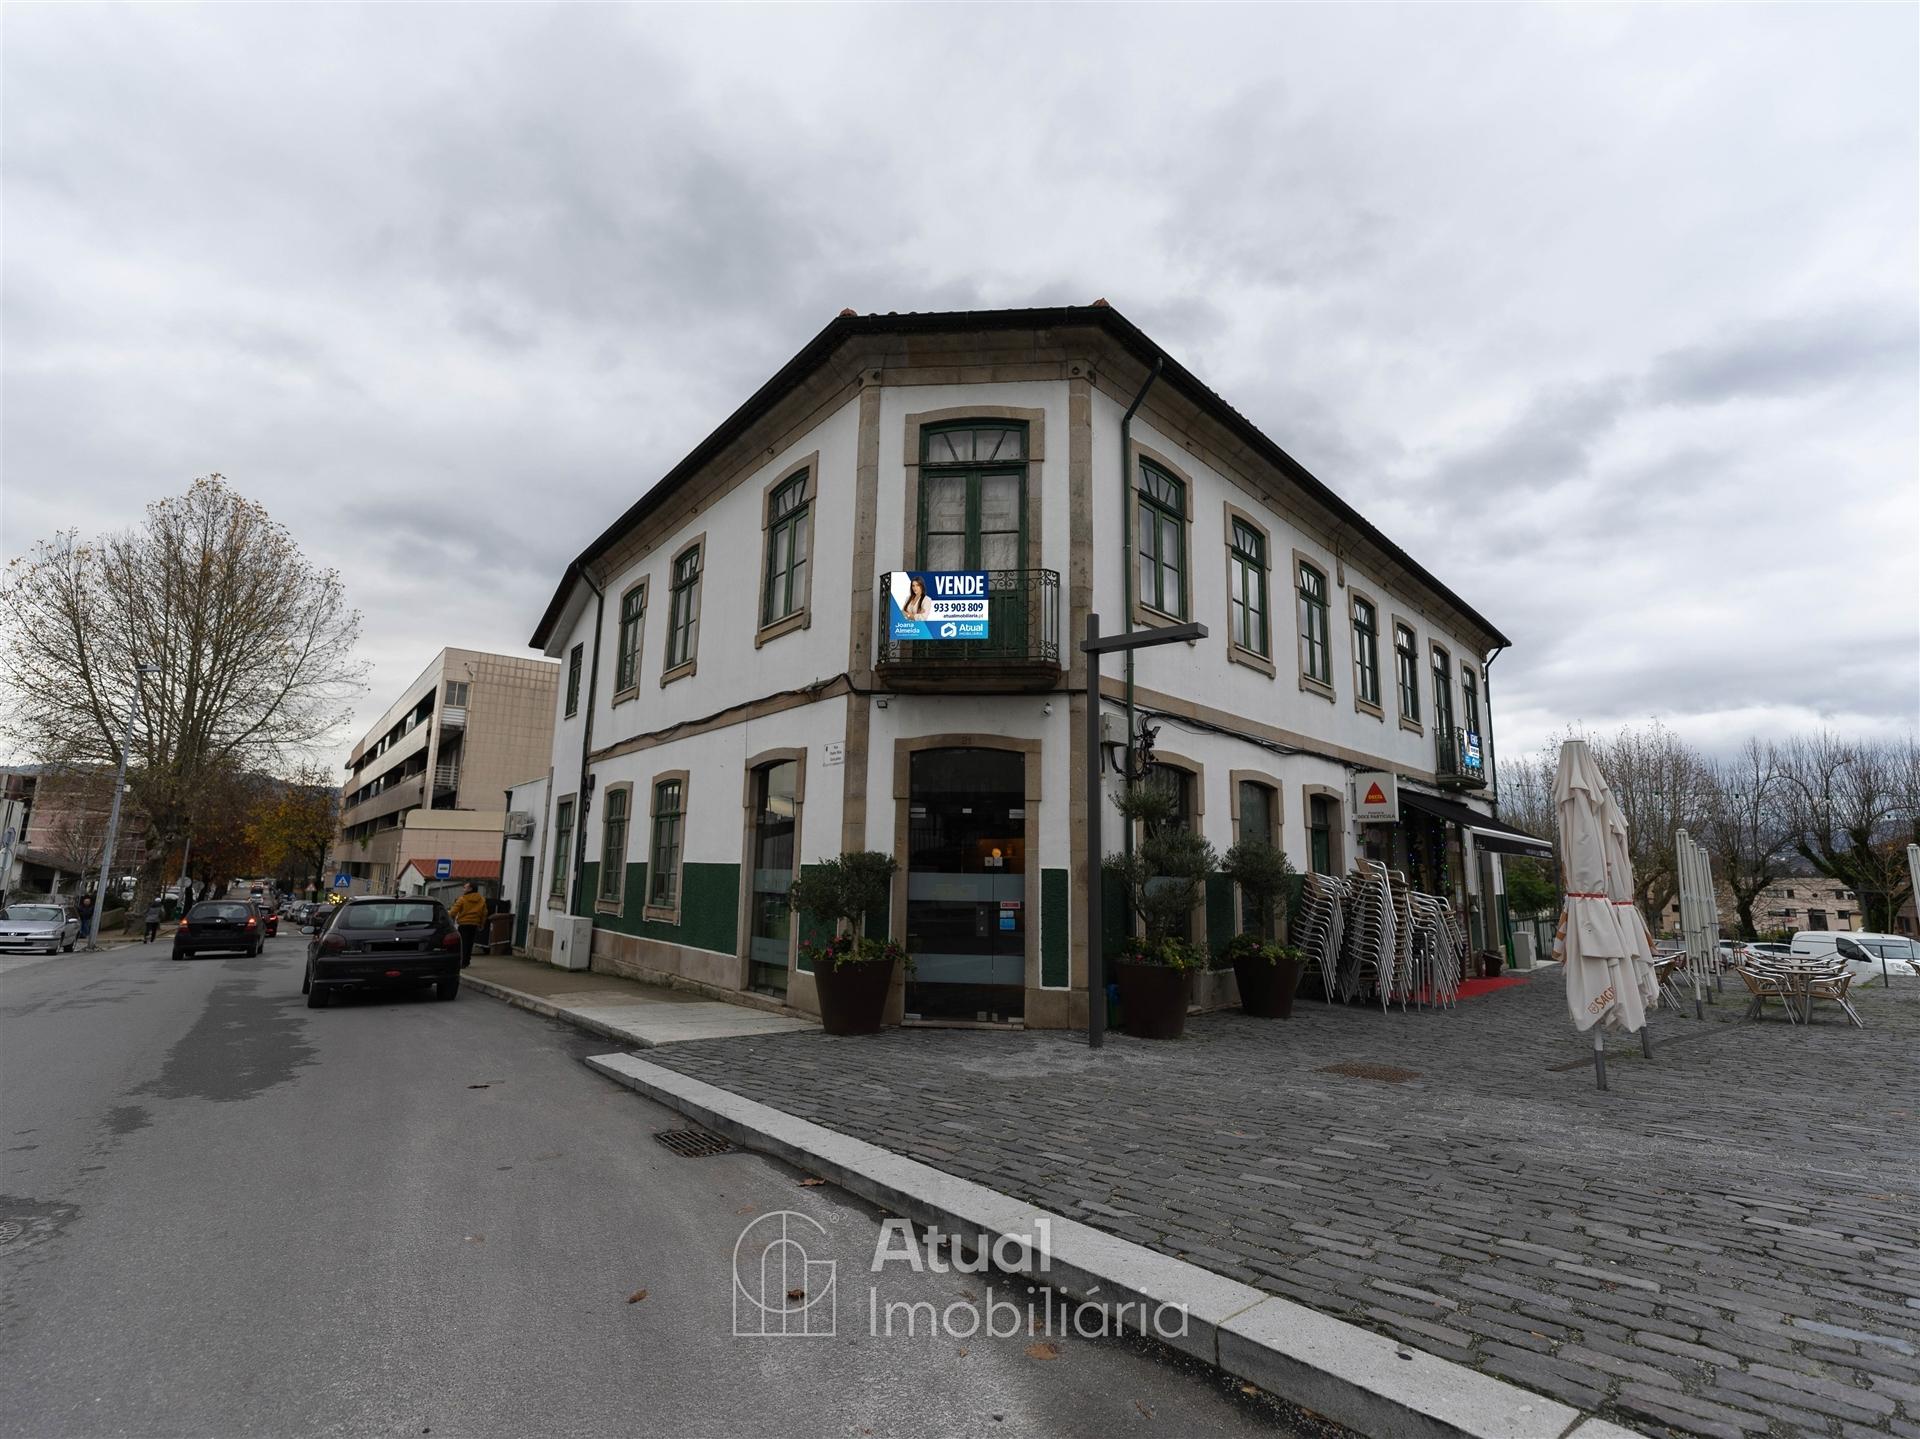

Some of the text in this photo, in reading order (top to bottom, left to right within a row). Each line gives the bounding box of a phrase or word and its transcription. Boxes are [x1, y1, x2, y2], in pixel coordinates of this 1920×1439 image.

[935, 575, 984, 595] VENDE
[934, 603, 983, 612] 933 903 809
[959, 623, 983, 632] Atual
